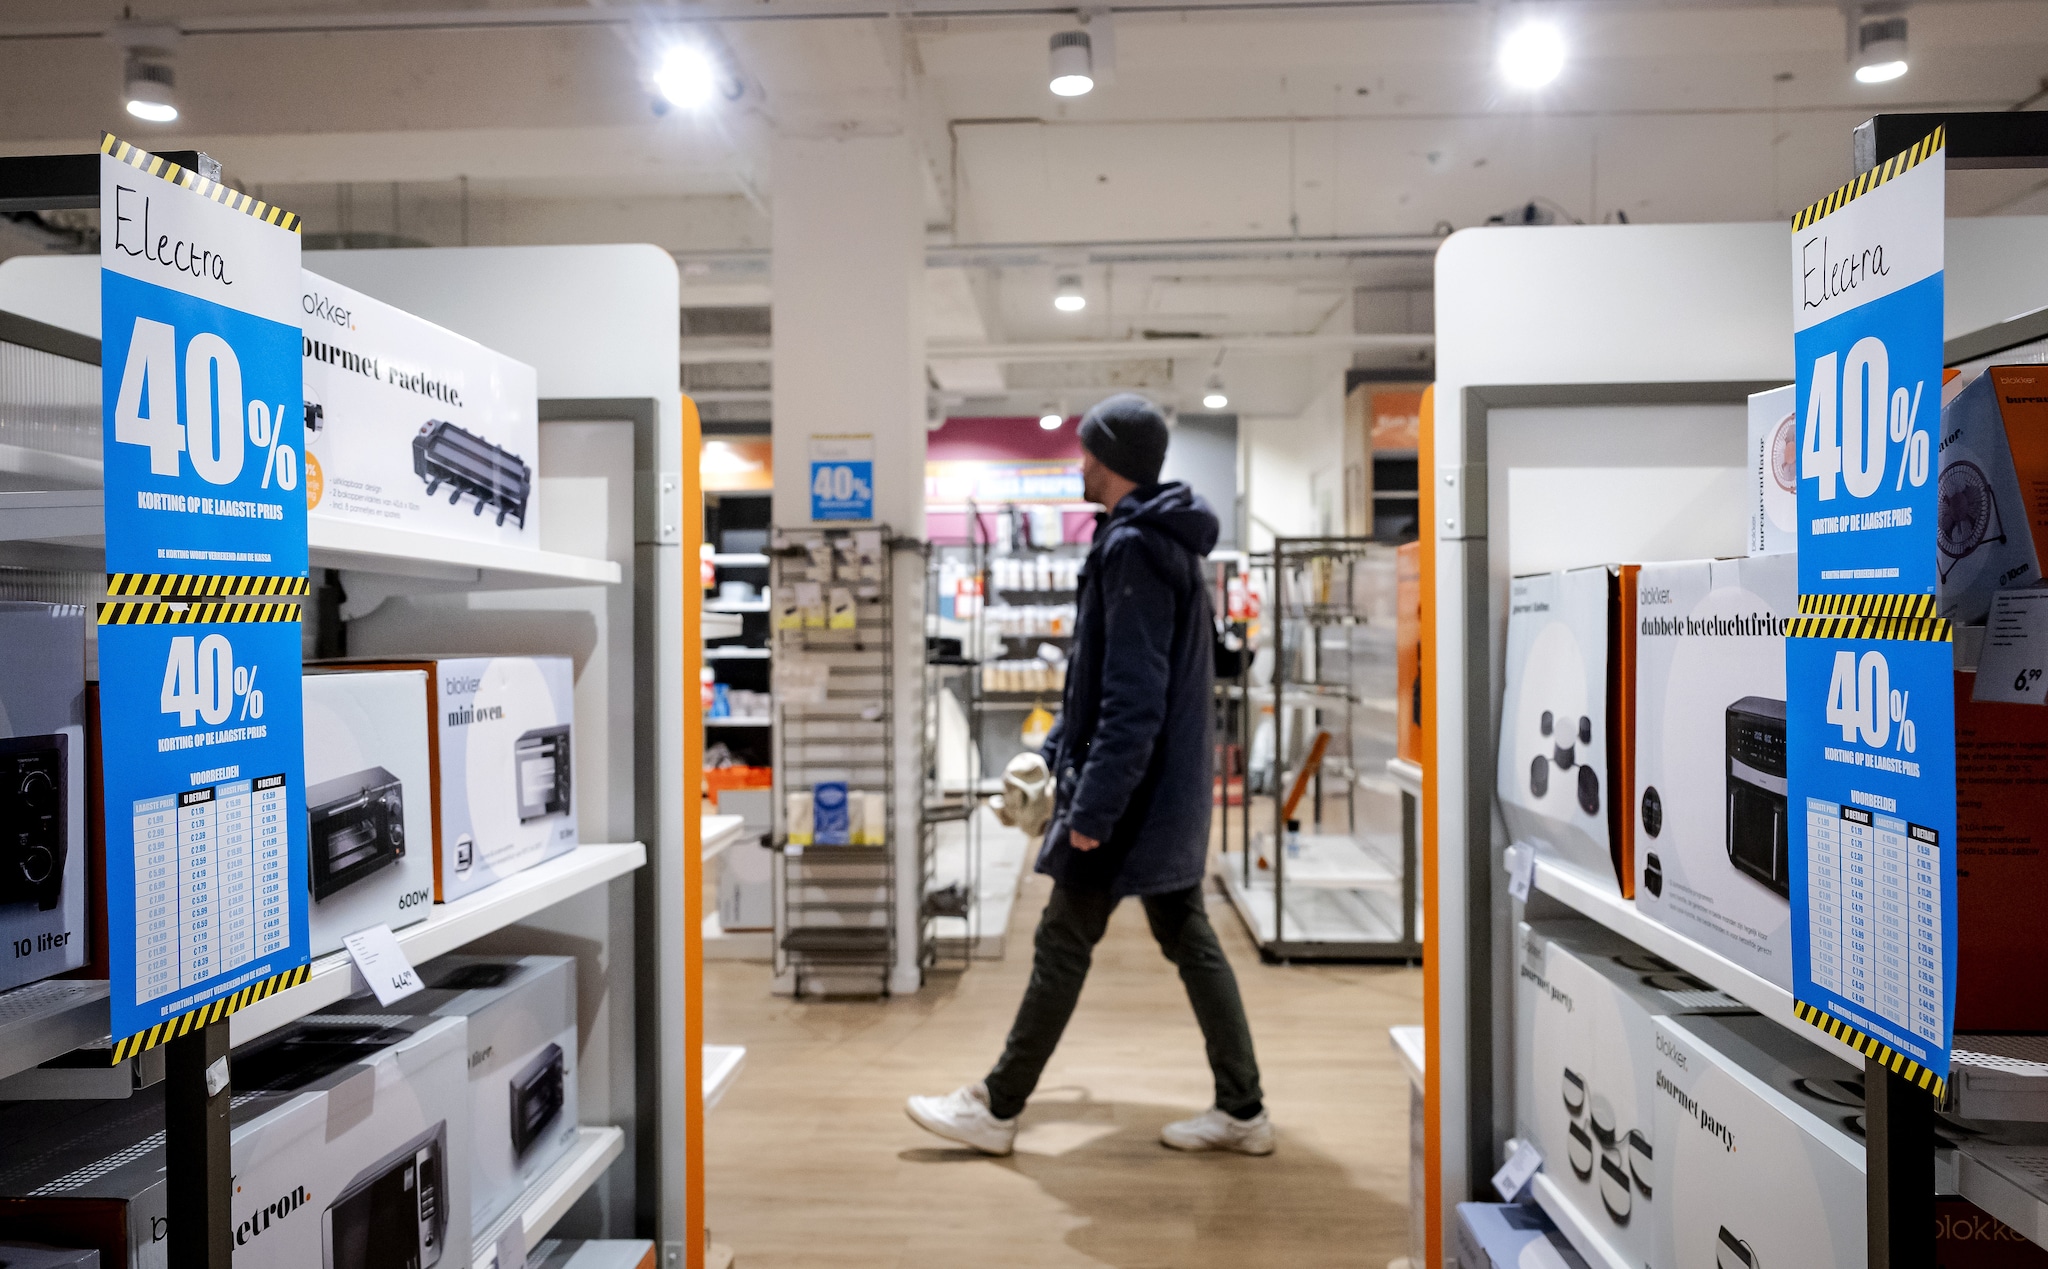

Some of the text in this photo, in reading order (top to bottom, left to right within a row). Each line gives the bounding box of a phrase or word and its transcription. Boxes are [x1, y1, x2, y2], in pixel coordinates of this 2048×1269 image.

[116, 185, 232, 285] Electra
[1803, 236, 1891, 311] Electra
[302, 293, 356, 331] okker.
[302, 336, 463, 408] ourmet raclette.
[114, 316, 297, 490] 40%
[1801, 336, 1929, 502] 40%
[813, 465, 872, 500] 40%
[138, 491, 283, 520] KORTING OP DE LAAGSTE PRIJS
[1811, 507, 1912, 536] KORTING OP DE LAAGSTE PRIJS
[157, 549, 166, 558] DE
[166, 549, 189, 560] KORTING
[2006, 562, 2029, 582] 10cm
[1640, 587, 1673, 606] blokker.
[1641, 611, 1788, 637] dubbele heteluchtfrite
[161, 633, 264, 728] 40%
[446, 676, 482, 695] blokker.
[2014, 668, 2042, 691] 6.99
[1826, 650, 1916, 753] 40%
[448, 704, 506, 727] mini oven.
[158, 725, 267, 753] KORTING OP DE LAAGSTE PRIJS
[1824, 747, 1920, 778] KORTING OP DE LAAGSTE PRIJS
[190, 765, 239, 786] VOORBEELDEN
[258, 776, 282, 788] U BETAALT
[135, 798, 175, 813] LAAGSTE PRIJS
[184, 790, 211, 804] U BETAALT
[1850, 789, 1897, 813] VOORBEELDEN
[195, 806, 205, 815] 1.19
[196, 819, 205, 828] 1.79
[195, 831, 206, 841] 2.39
[195, 844, 206, 854] 2.99
[196, 856, 206, 866] 3.59
[196, 869, 206, 878] 4.19
[197, 882, 207, 891] 4.79
[196, 894, 207, 904] 5.39
[398, 887, 430, 910] 600W
[196, 907, 208, 917] 5.99
[196, 919, 208, 929] 6.59
[13, 930, 71, 958] 10 liter
[198, 932, 207, 941] 7.19
[198, 944, 208, 954] 7.79
[197, 957, 209, 967] 8.39
[198, 969, 209, 980] 8.99
[160, 1006, 169, 1017] DE
[169, 996, 193, 1014] KORTING
[193, 988, 213, 1003] WORDT
[1656, 1069, 1737, 1153] gourmet party.
[232, 1185, 311, 1251] etron.
